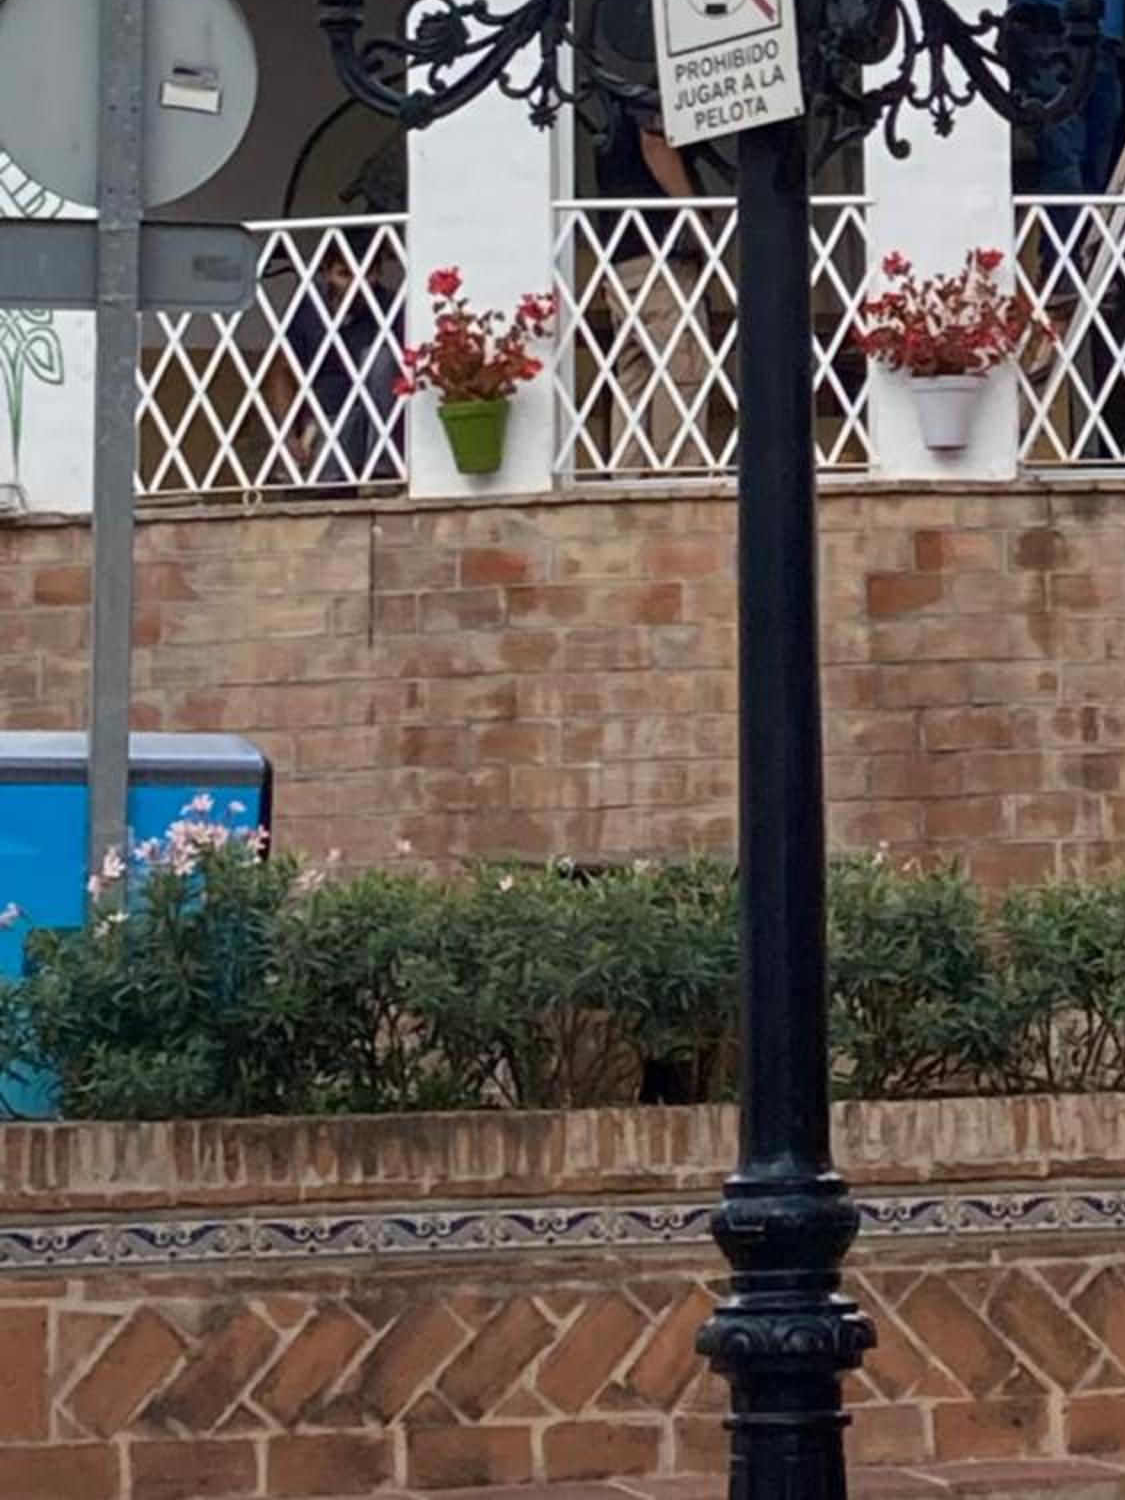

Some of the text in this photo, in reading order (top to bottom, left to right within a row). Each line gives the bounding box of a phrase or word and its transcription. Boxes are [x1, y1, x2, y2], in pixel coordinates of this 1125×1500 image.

[675, 39, 778, 82] PROHIBIDO
[674, 64, 784, 111] JUGAR A LA
[694, 95, 768, 131] PELOTA
